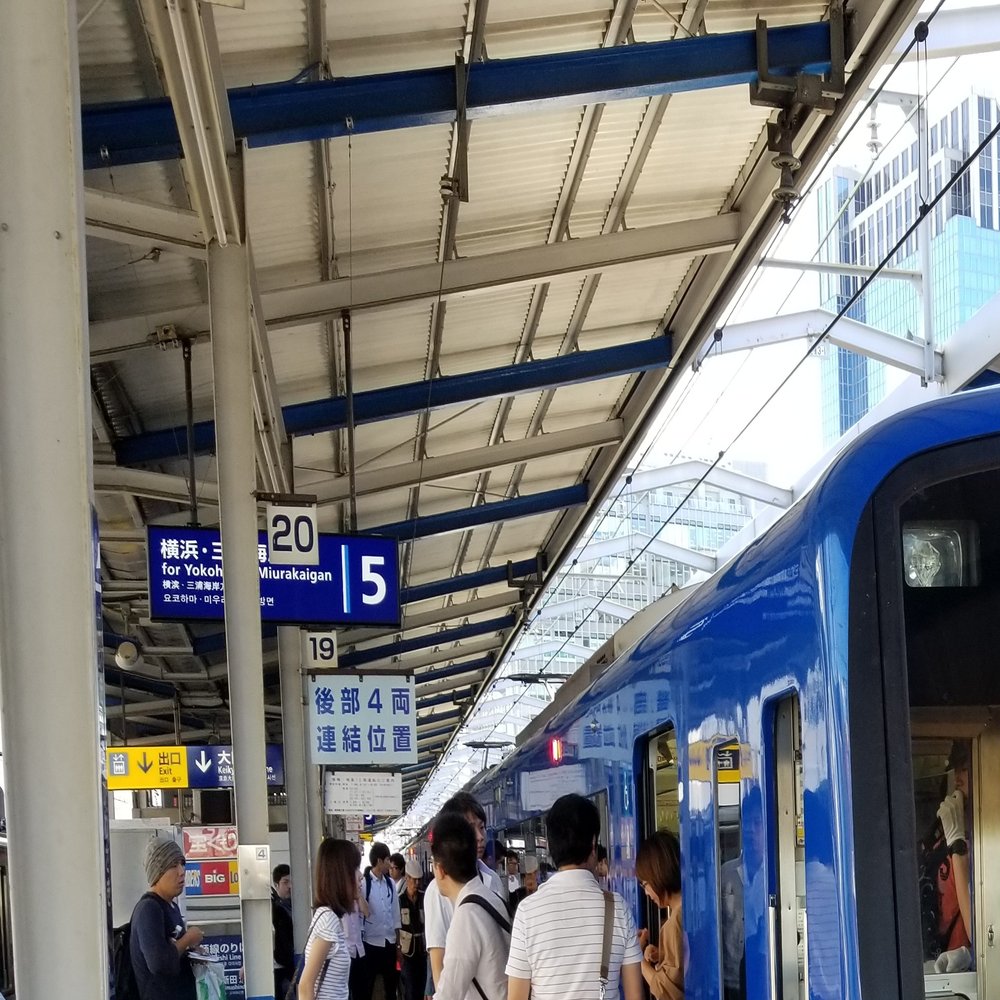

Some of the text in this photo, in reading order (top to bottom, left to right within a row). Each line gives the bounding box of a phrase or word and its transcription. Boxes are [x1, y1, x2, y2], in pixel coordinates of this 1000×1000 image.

[272, 514, 314, 552] 20
[162, 562, 332, 583] for Yokoh Miurakaigan
[361, 555, 387, 605] 5
[309, 637, 335, 660] 19
[314, 687, 410, 715] 後部4両
[316, 725, 412, 753] 連結位置
[158, 752, 181, 766] 出口
[217, 750, 233, 765] 大
[159, 767, 172, 775] Exit
[217, 766, 234, 776] Keiky
[257, 848, 266, 859] 4
